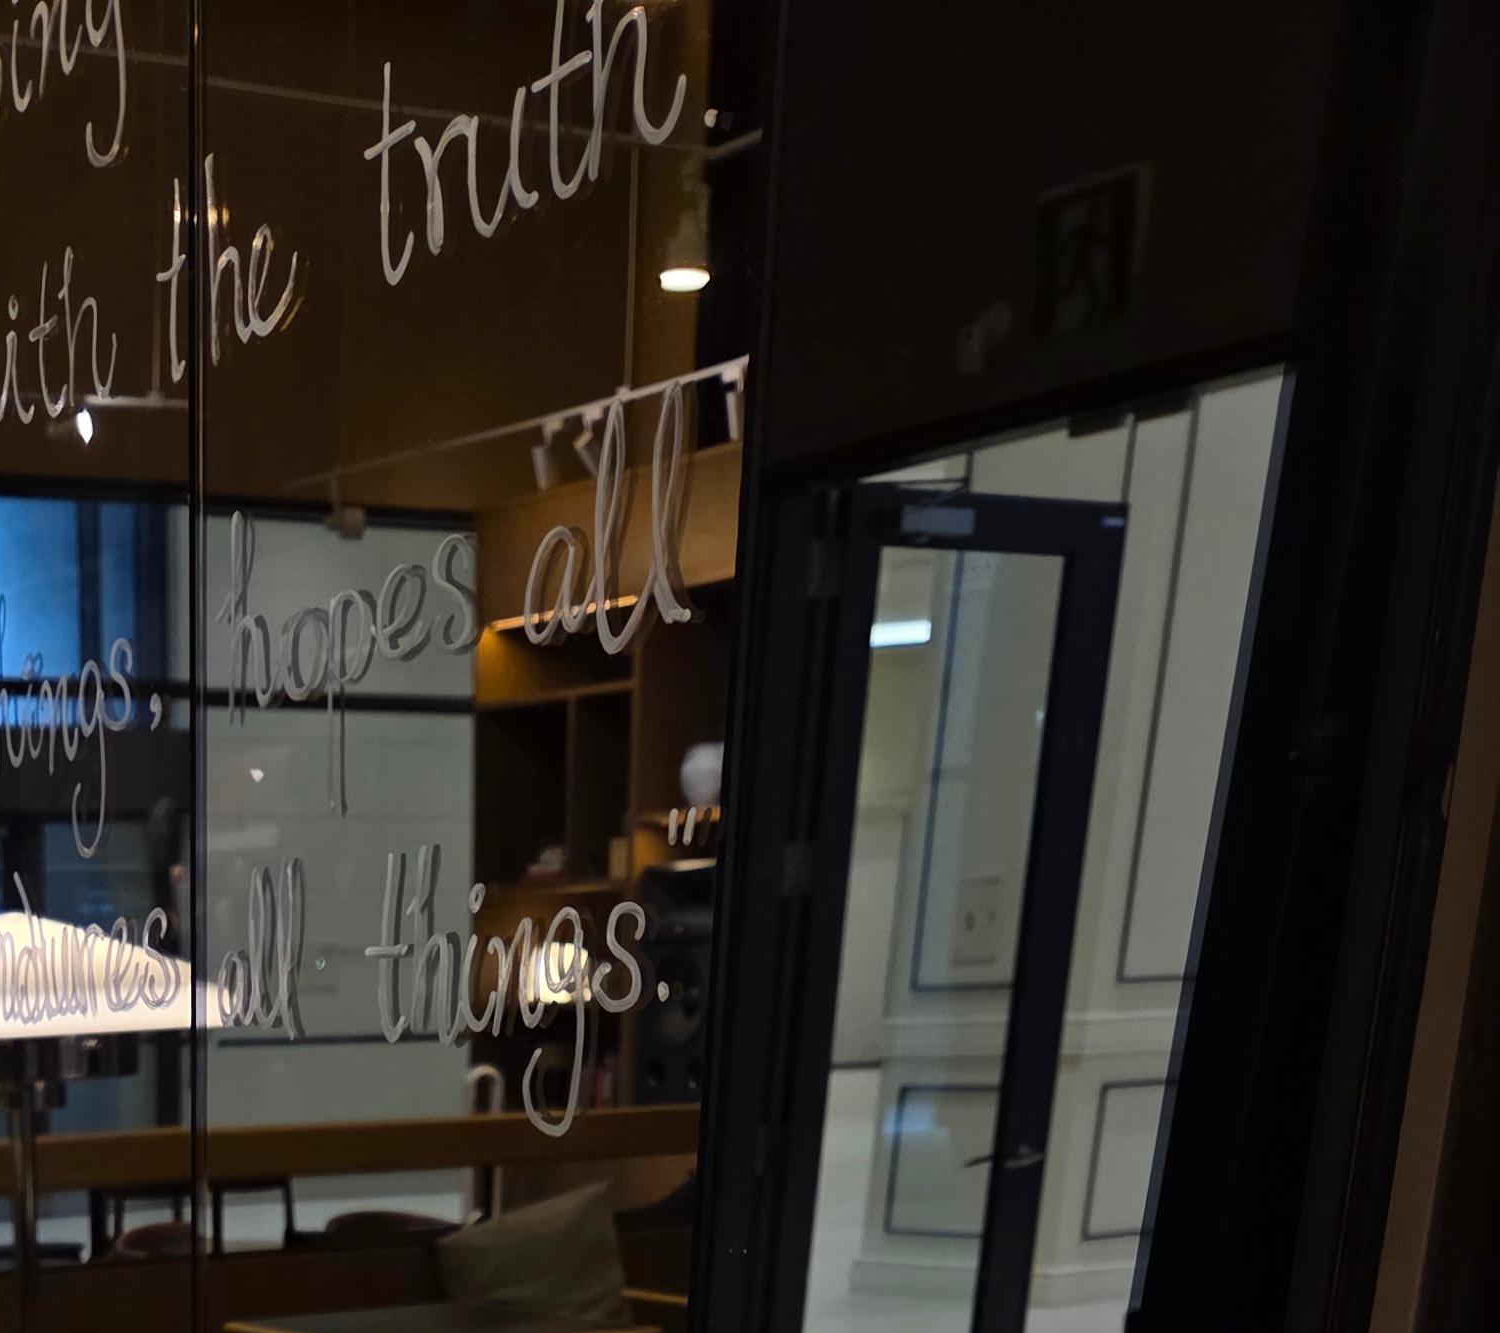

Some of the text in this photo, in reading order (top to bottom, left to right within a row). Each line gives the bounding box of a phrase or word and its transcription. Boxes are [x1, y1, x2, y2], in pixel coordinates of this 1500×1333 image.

[156, 152, 300, 385] the
[363, 0, 720, 287] truth.
[214, 509, 480, 818] hopes
[523, 382, 696, 656] all
[217, 854, 305, 1041] all
